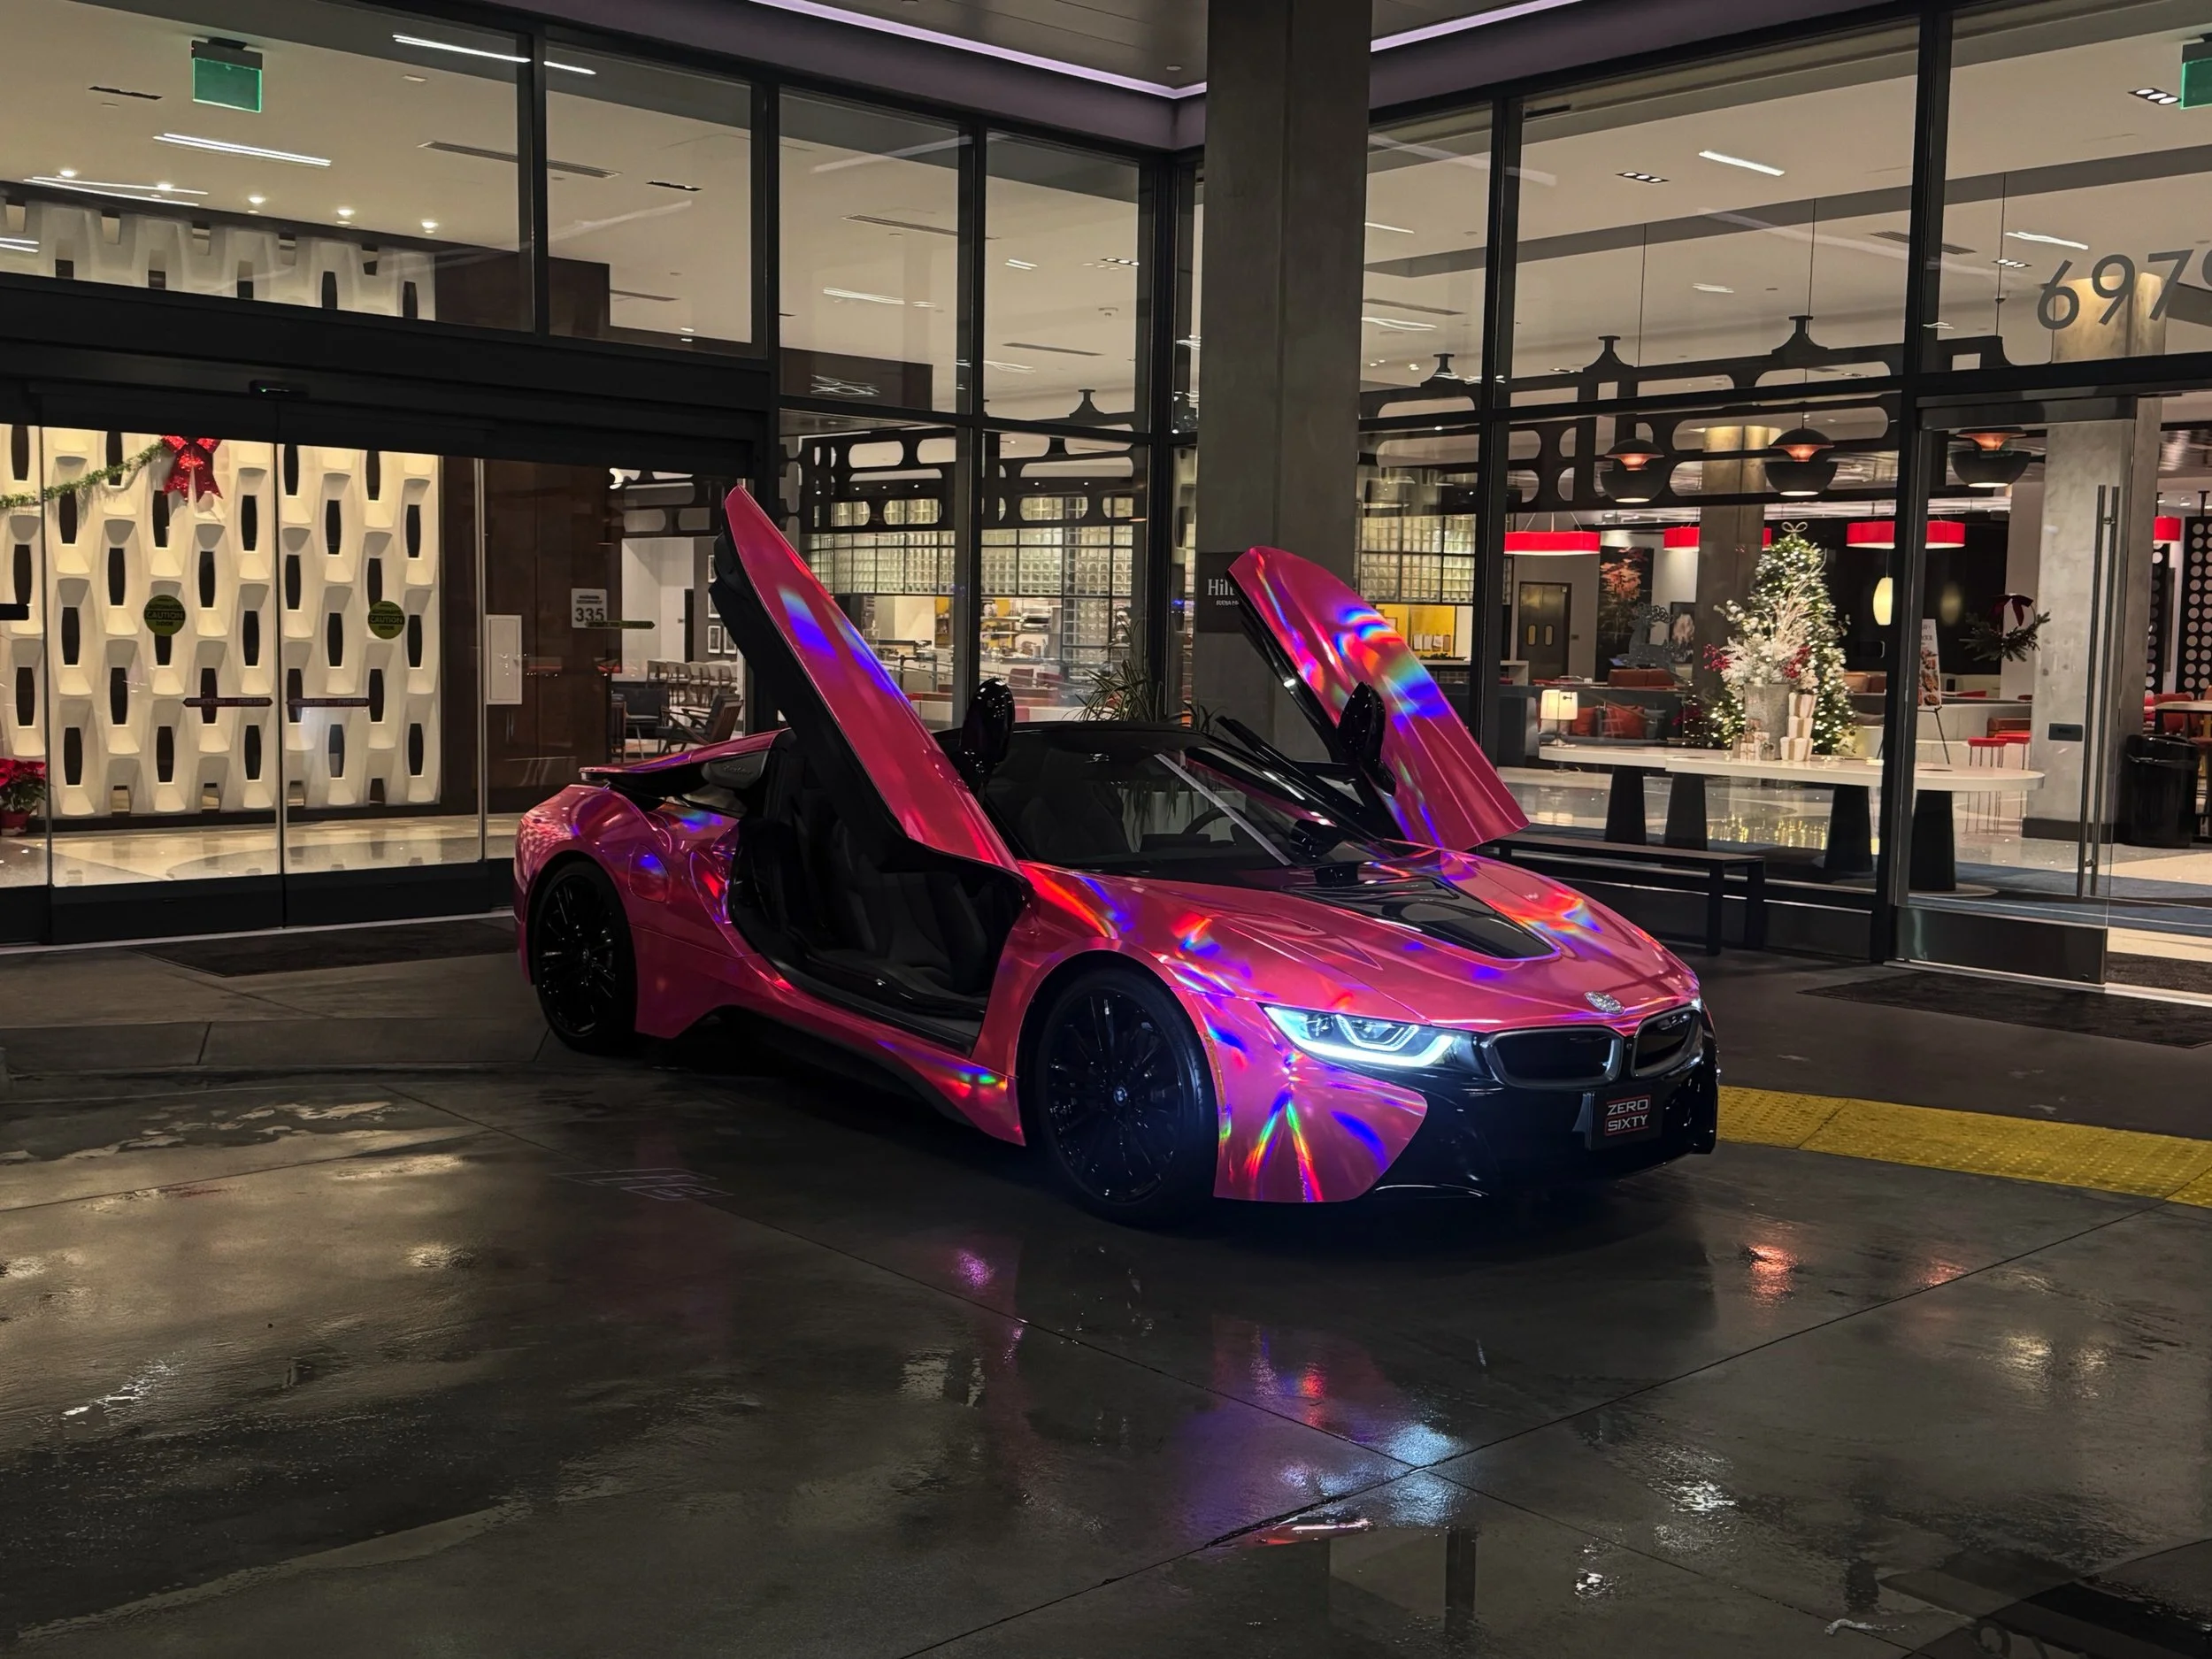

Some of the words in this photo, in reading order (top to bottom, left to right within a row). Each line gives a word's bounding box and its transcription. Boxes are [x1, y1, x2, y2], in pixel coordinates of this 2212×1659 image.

[2038, 249, 2212, 330] 697
[575, 608, 604, 622] 335
[1607, 1099, 1648, 1116] ZERO
[1607, 1115, 1647, 1132] SIXTY
